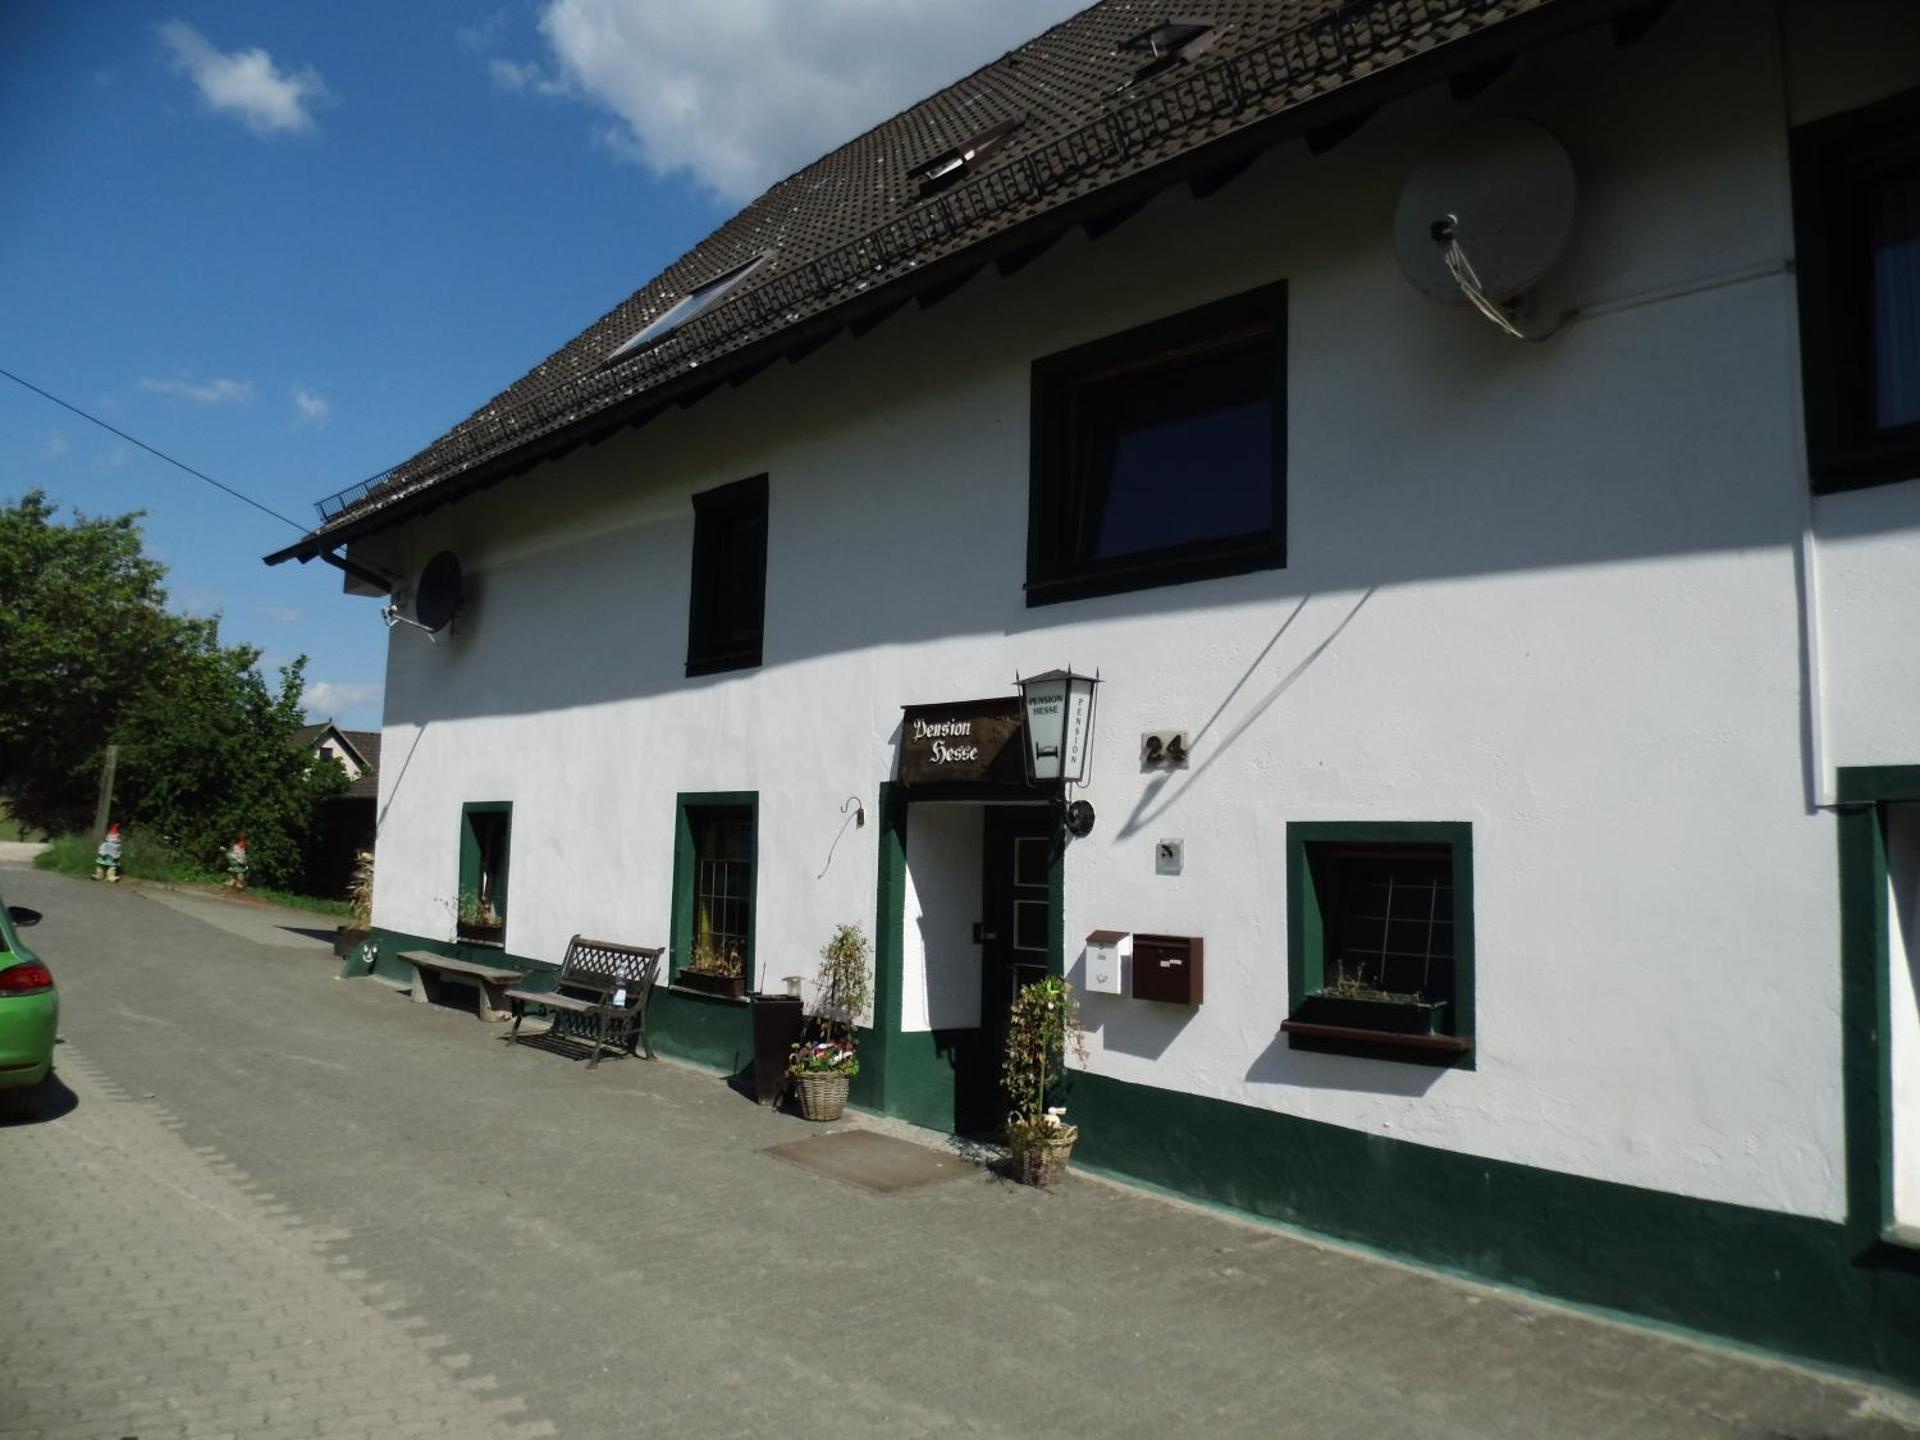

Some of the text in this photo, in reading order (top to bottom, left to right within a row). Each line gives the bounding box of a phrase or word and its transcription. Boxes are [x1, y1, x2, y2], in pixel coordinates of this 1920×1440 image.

[1028, 695, 1064, 705] PENSION
[1033, 705, 1058, 715] HESSE
[913, 718, 971, 744] Pension
[1070, 698, 1084, 764] PENSION
[929, 740, 978, 765] Hesse
[1146, 735, 1187, 763] 24
